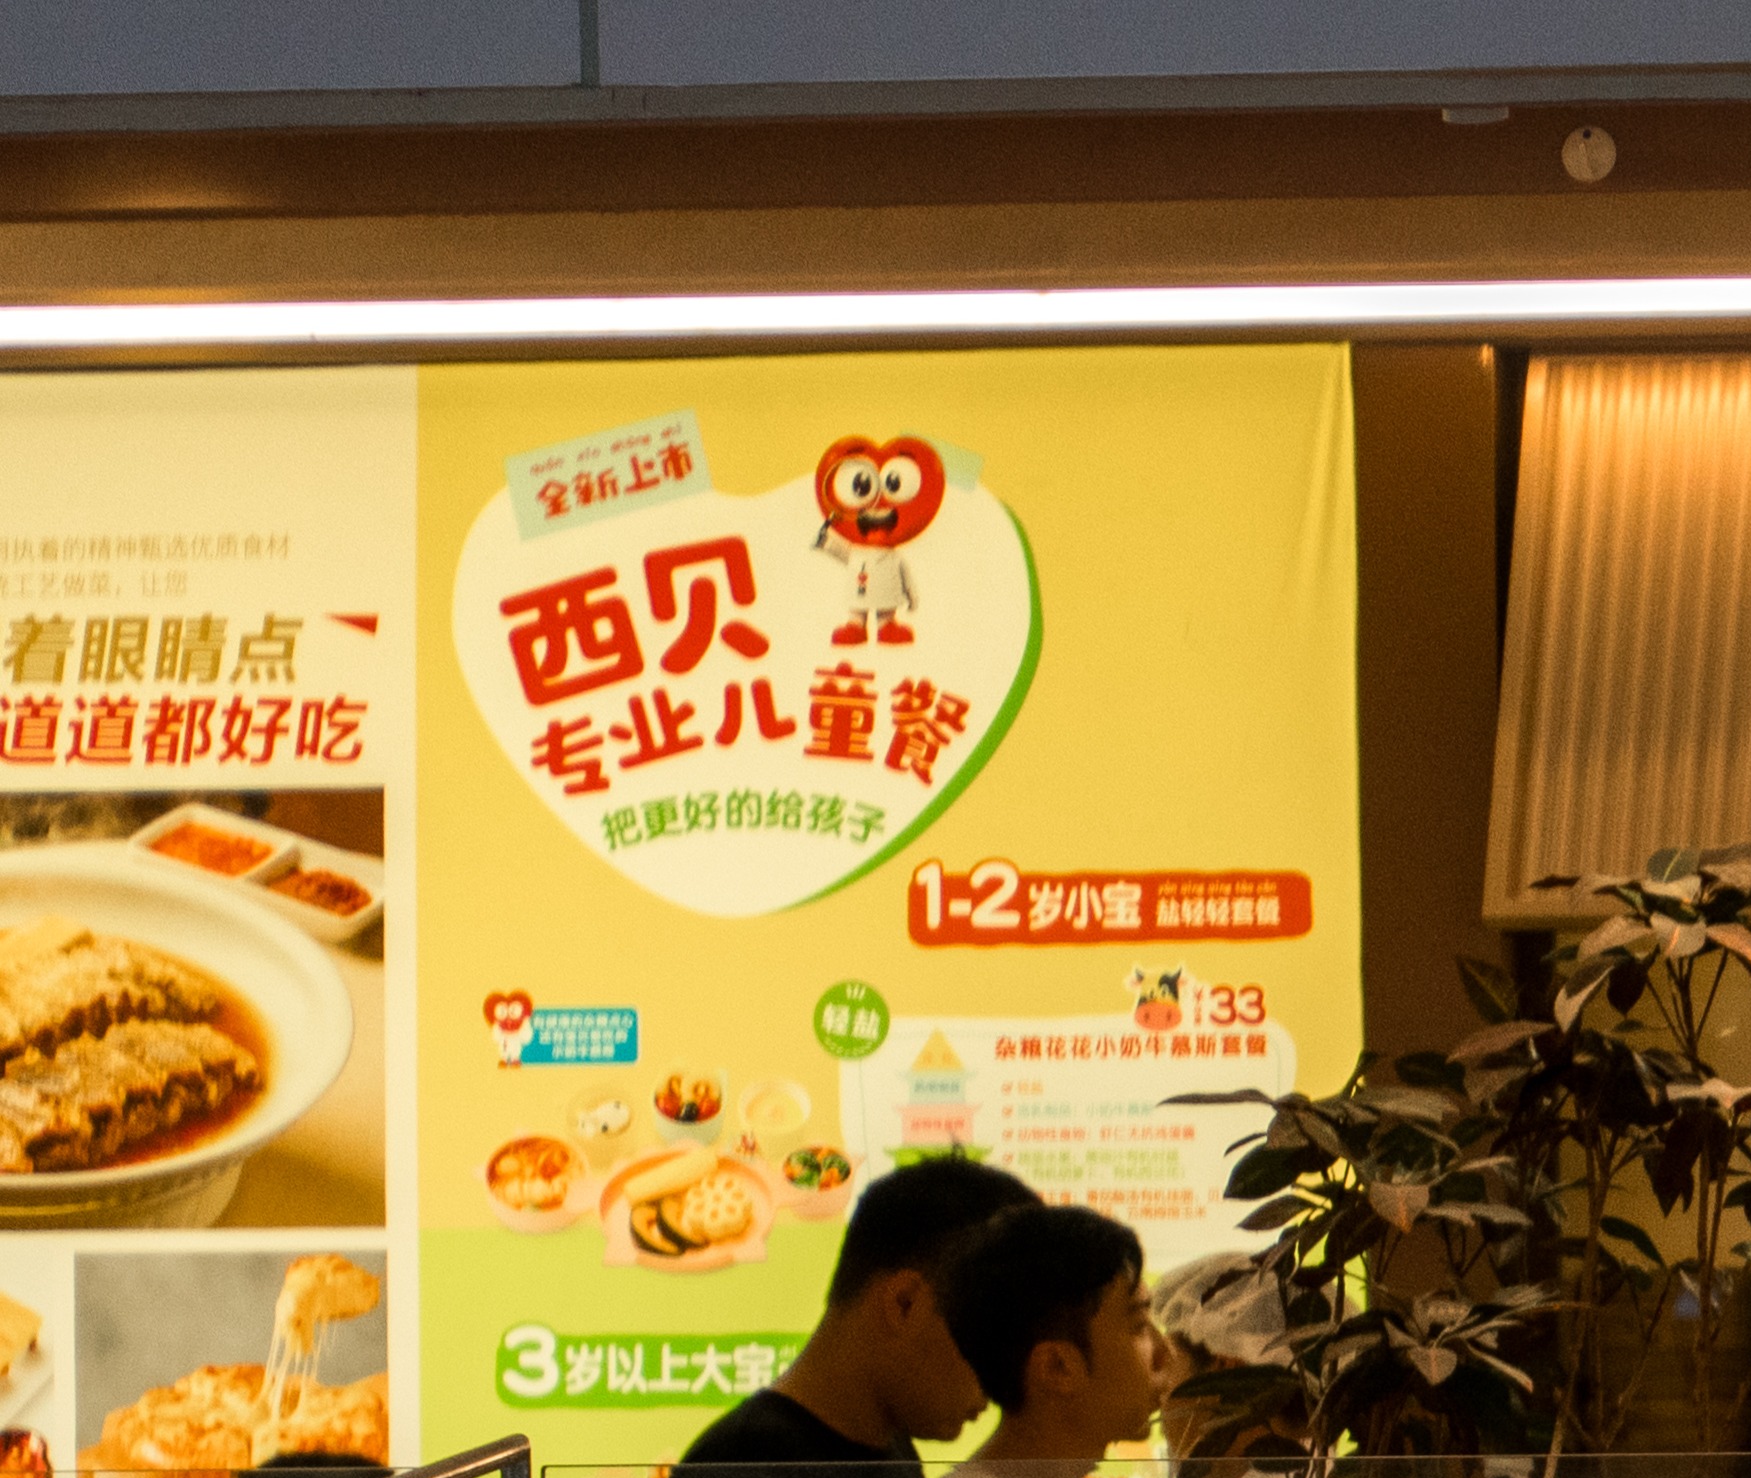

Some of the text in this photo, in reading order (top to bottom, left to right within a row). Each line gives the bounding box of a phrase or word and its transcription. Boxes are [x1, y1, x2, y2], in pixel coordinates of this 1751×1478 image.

[535, 441, 693, 520] 全新上市
[2, 612, 304, 685] 着眼睛点
[498, 535, 770, 707] 西贝
[0, 694, 368, 767] 道道都好吃
[530, 662, 970, 796] 专业儿童餐
[600, 787, 887, 853] 把更好的给孩子
